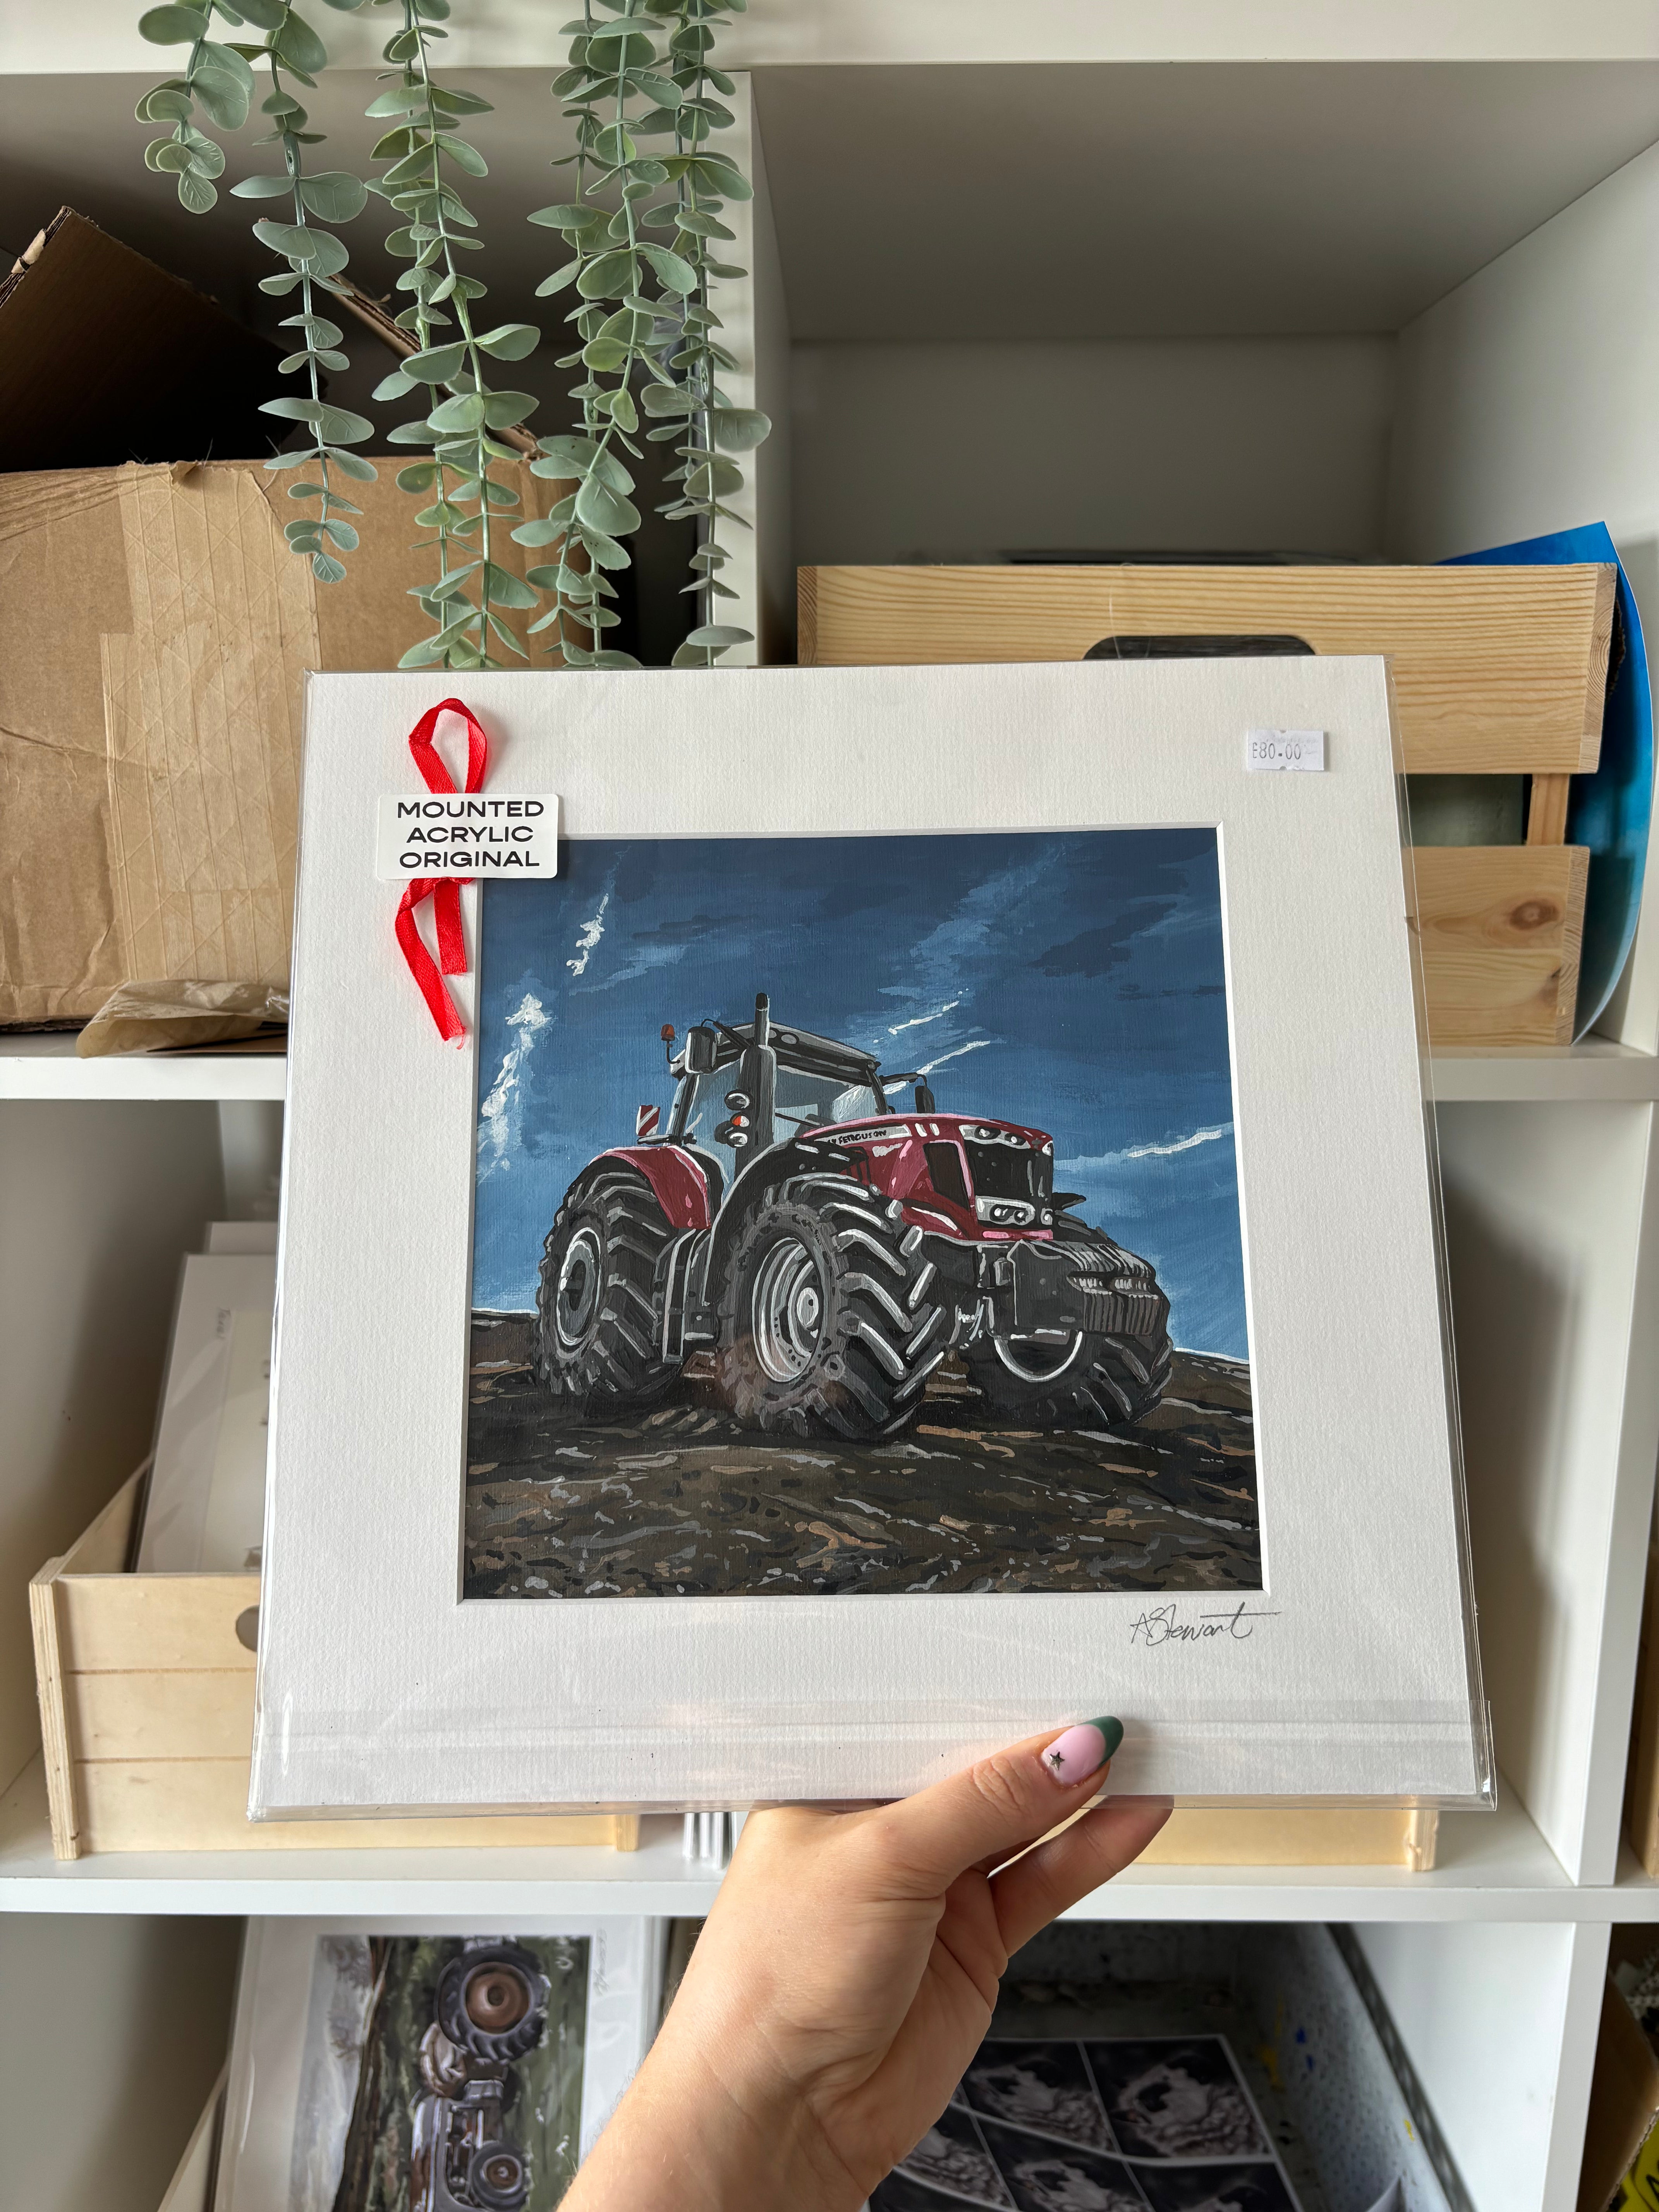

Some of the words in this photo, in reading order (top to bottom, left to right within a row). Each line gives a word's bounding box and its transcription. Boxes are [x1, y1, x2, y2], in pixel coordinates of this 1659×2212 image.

[1252, 742, 1301, 760] £80.00
[398, 801, 544, 818] MOUNTED
[406, 826, 533, 843] ACRYLIC
[400, 851, 539, 868] ORIGINAL
[838, 1130, 886, 1144] FERGUSON
